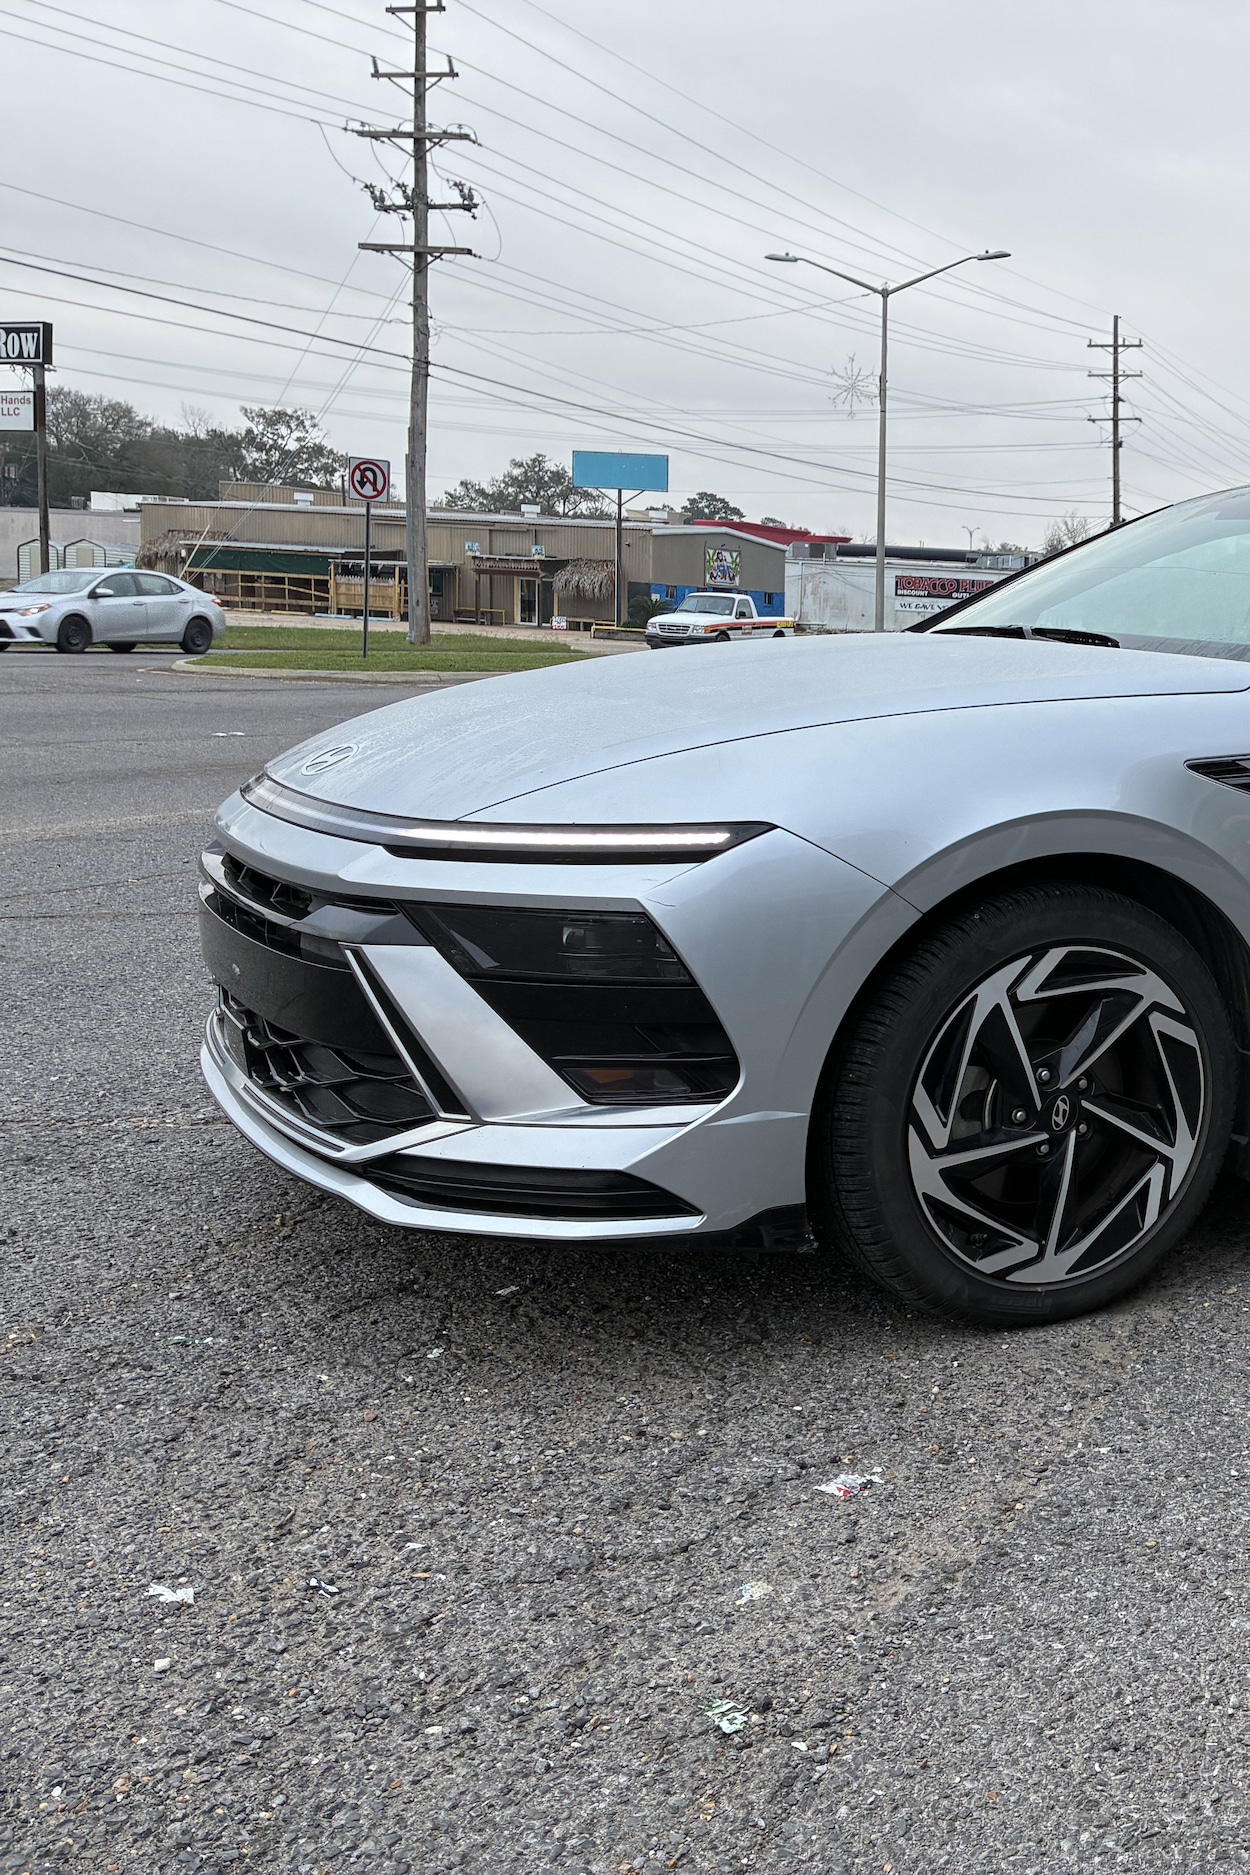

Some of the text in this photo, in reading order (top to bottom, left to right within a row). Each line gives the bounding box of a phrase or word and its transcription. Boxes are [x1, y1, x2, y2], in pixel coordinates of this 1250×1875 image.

[1, 395, 32, 405] Hands
[1, 407, 21, 416] LLC
[896, 577, 958, 595] TOBACCO
